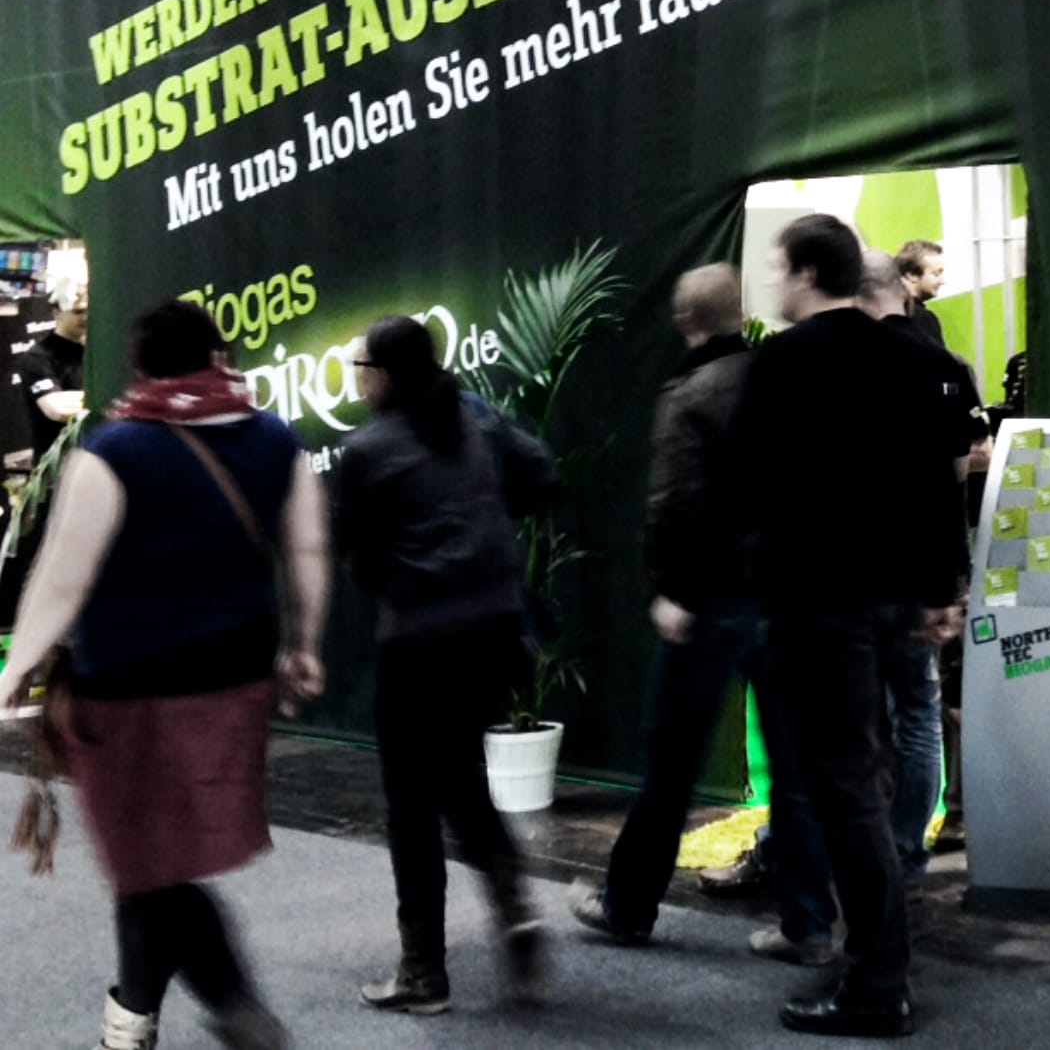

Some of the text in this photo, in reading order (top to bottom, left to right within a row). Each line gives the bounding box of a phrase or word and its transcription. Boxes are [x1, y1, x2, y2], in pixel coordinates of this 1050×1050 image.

[164, 161, 223, 231] Mit
[230, 139, 298, 202] uns
[304, 89, 417, 172] holen
[424, 49, 490, 120] Sie
[177, 264, 317, 350] iogas
[1002, 646, 1033, 666] TEC
